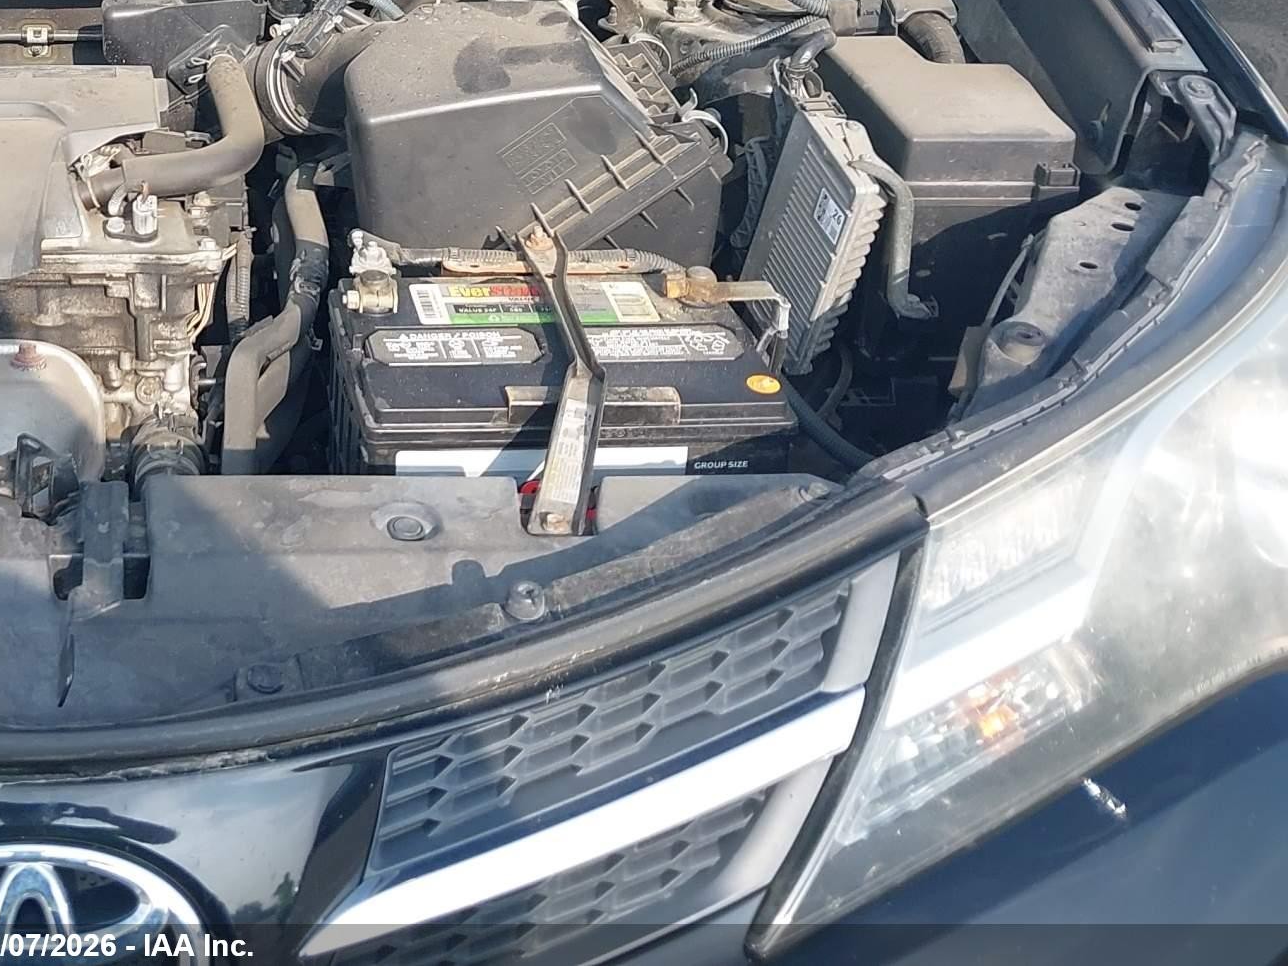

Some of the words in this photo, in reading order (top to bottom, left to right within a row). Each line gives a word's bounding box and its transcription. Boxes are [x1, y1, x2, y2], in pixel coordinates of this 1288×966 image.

[410, 332, 451, 340] DANGER
[694, 461, 727, 469] GROUP
[728, 460, 749, 468] SIZE
